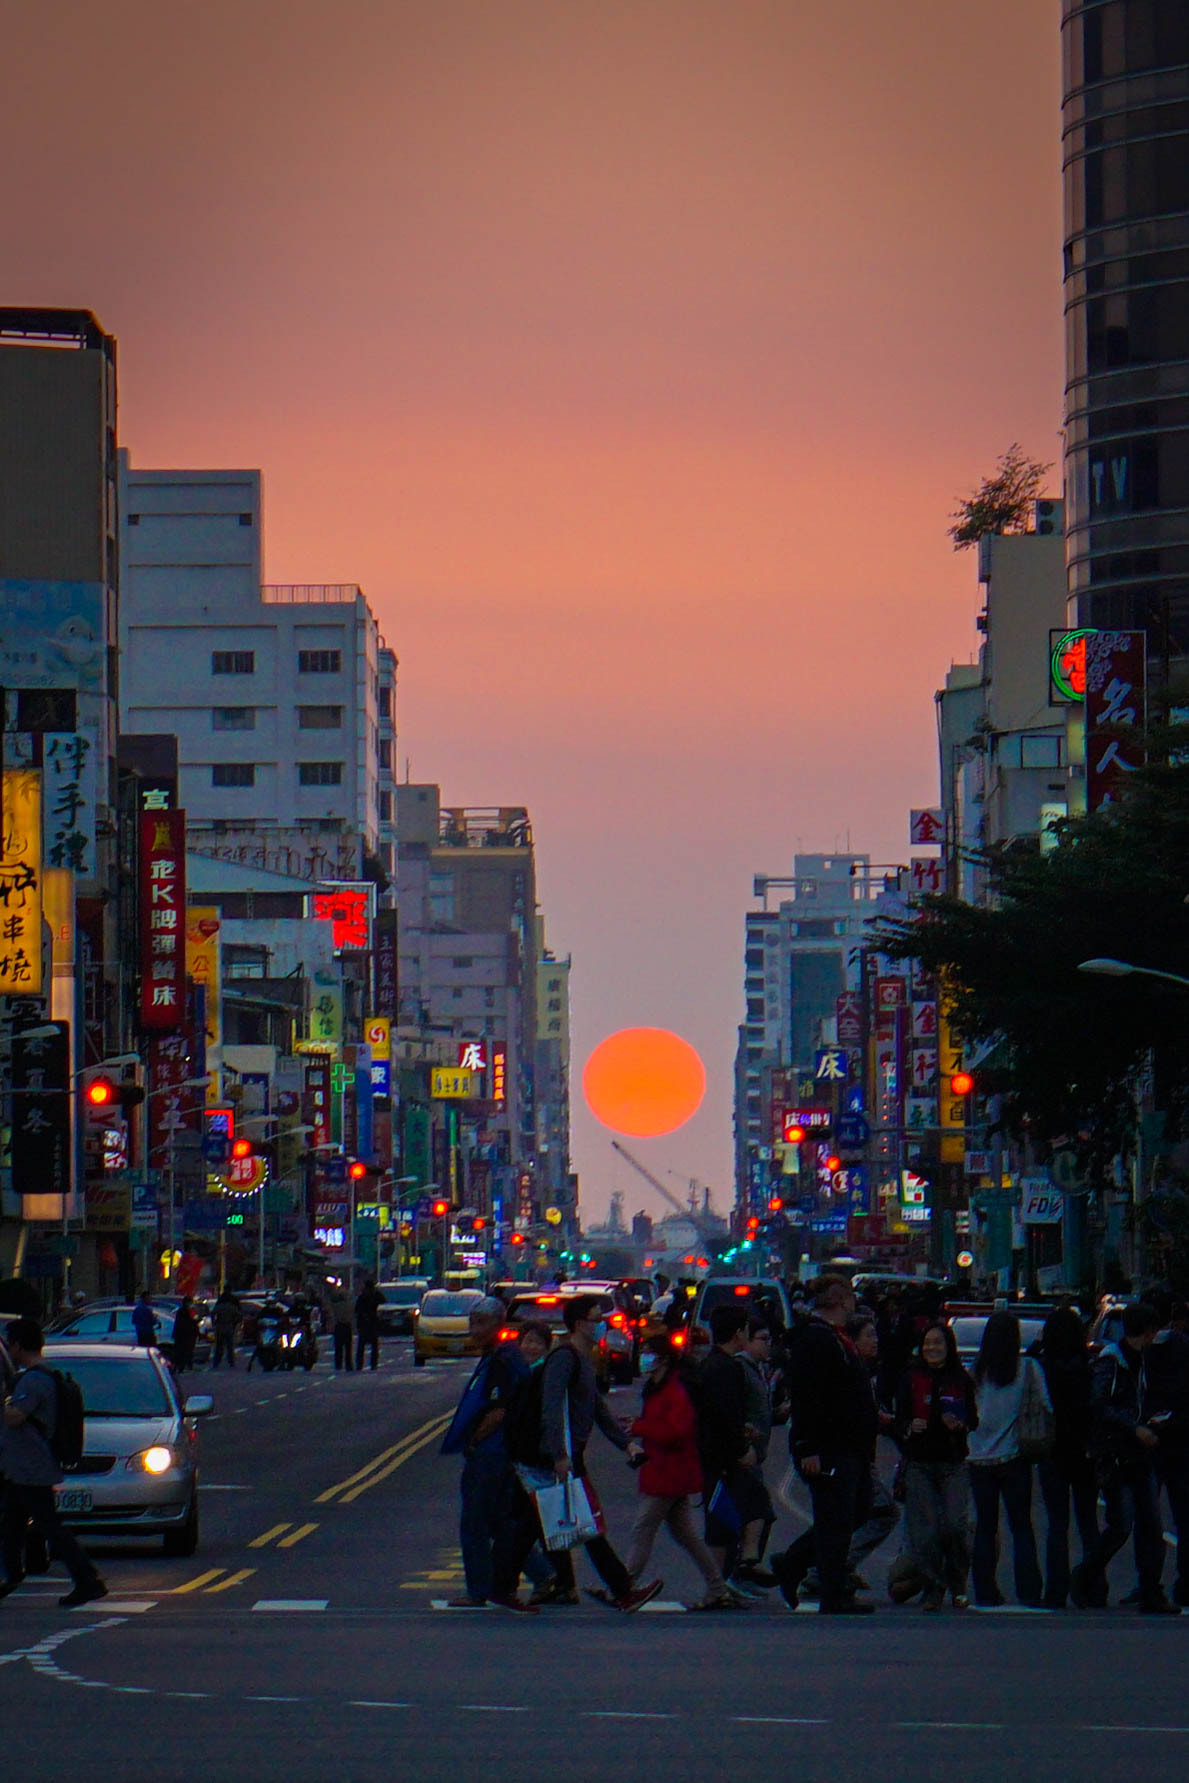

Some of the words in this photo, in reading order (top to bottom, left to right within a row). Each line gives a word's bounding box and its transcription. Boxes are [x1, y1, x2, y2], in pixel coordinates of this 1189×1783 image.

[47, 736, 91, 874] 伴手禮
[460, 1043, 487, 1071] 床
[815, 1052, 846, 1080] 床
